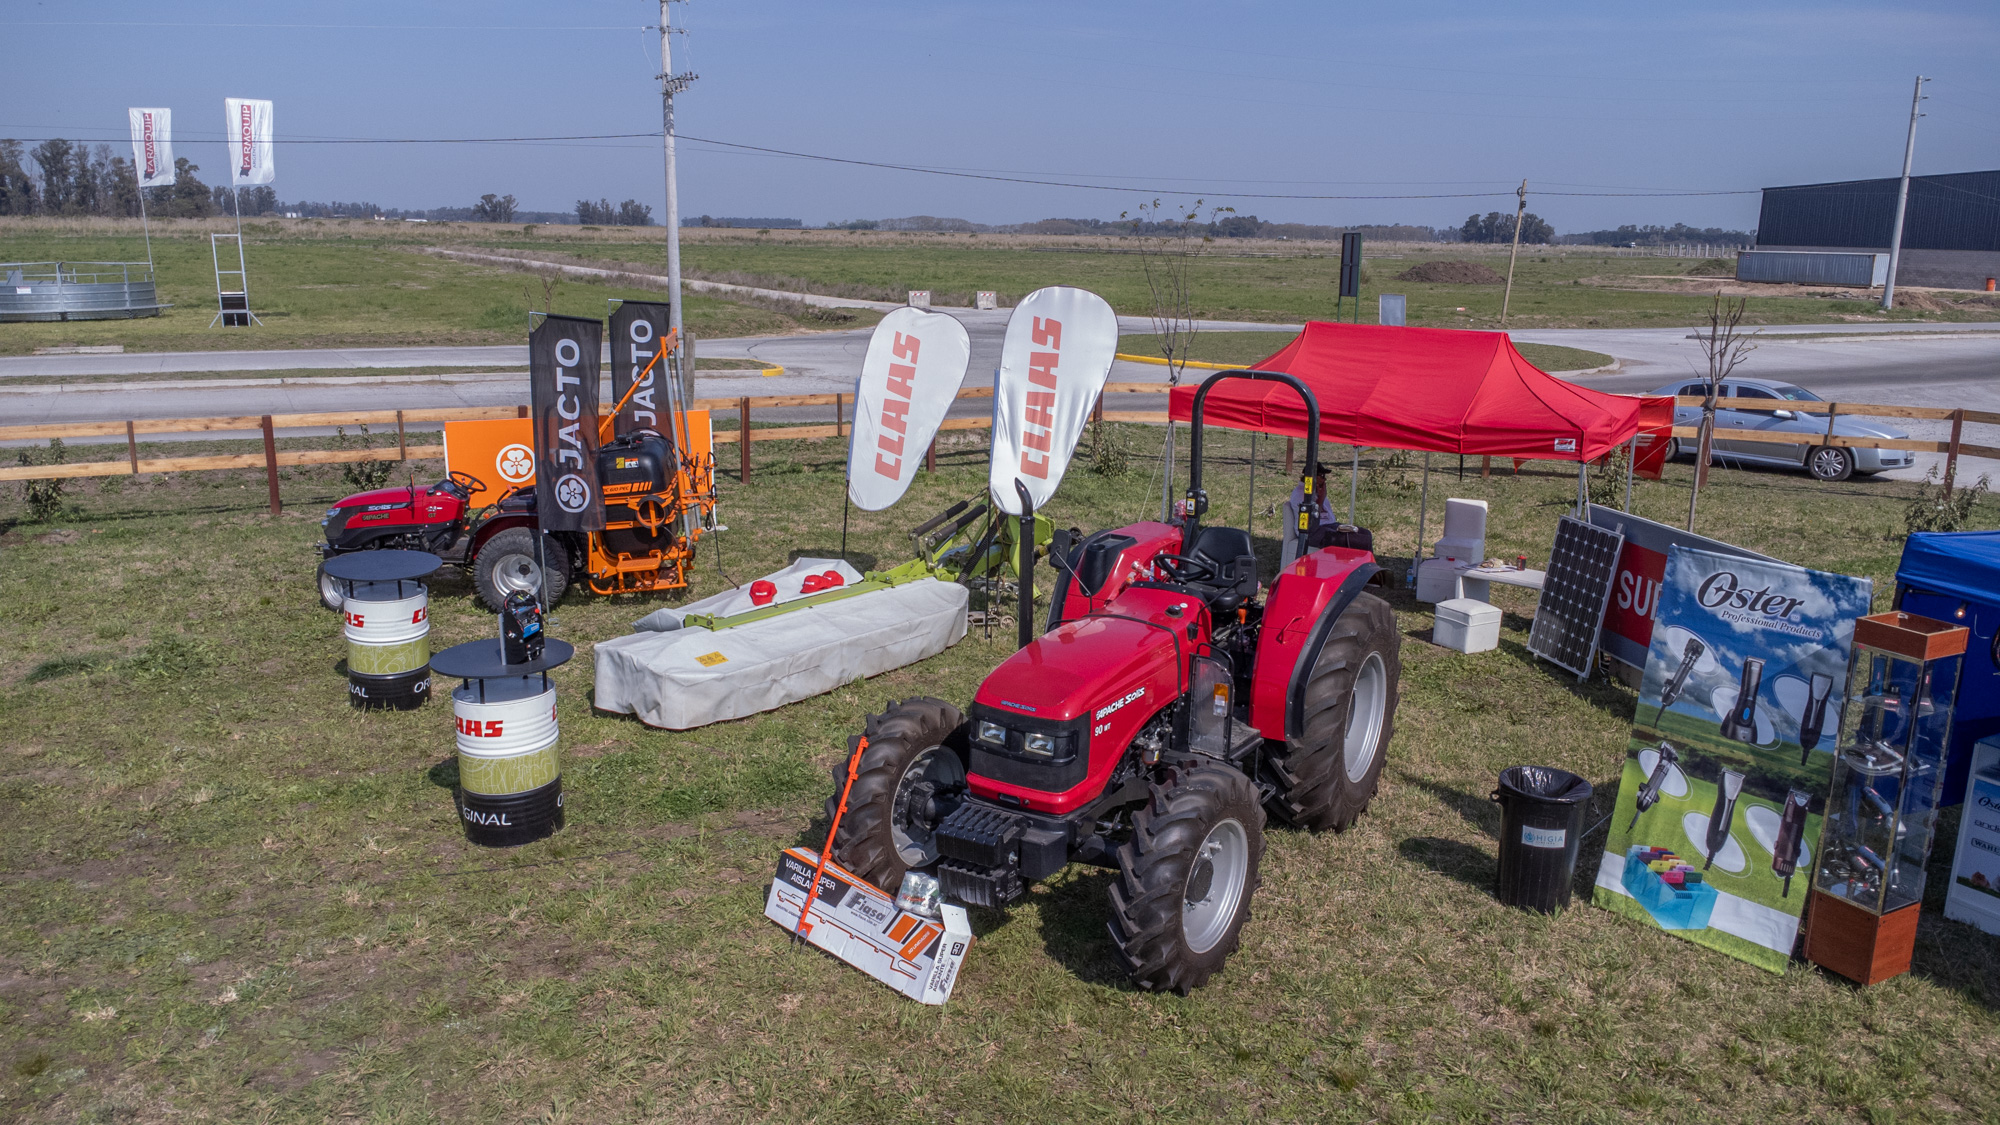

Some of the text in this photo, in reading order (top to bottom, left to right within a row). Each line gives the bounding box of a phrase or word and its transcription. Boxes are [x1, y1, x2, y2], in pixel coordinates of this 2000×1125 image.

[144, 112, 154, 172] FARMQUIP
[242, 104, 252, 169] FARMQUIP
[630, 319, 657, 426] JACTO
[1020, 316, 1062, 480] CLAAS
[555, 338, 583, 470] JACTO
[874, 331, 921, 481] CLAAS
[1697, 571, 1805, 618] Oster
[1721, 610, 1822, 639] Professional Products
[1094, 724, 1103, 736] 90
[785, 858, 815, 880] VARILLA
[790, 872, 824, 896] AISLATE
[844, 890, 886, 922] Fiasa
